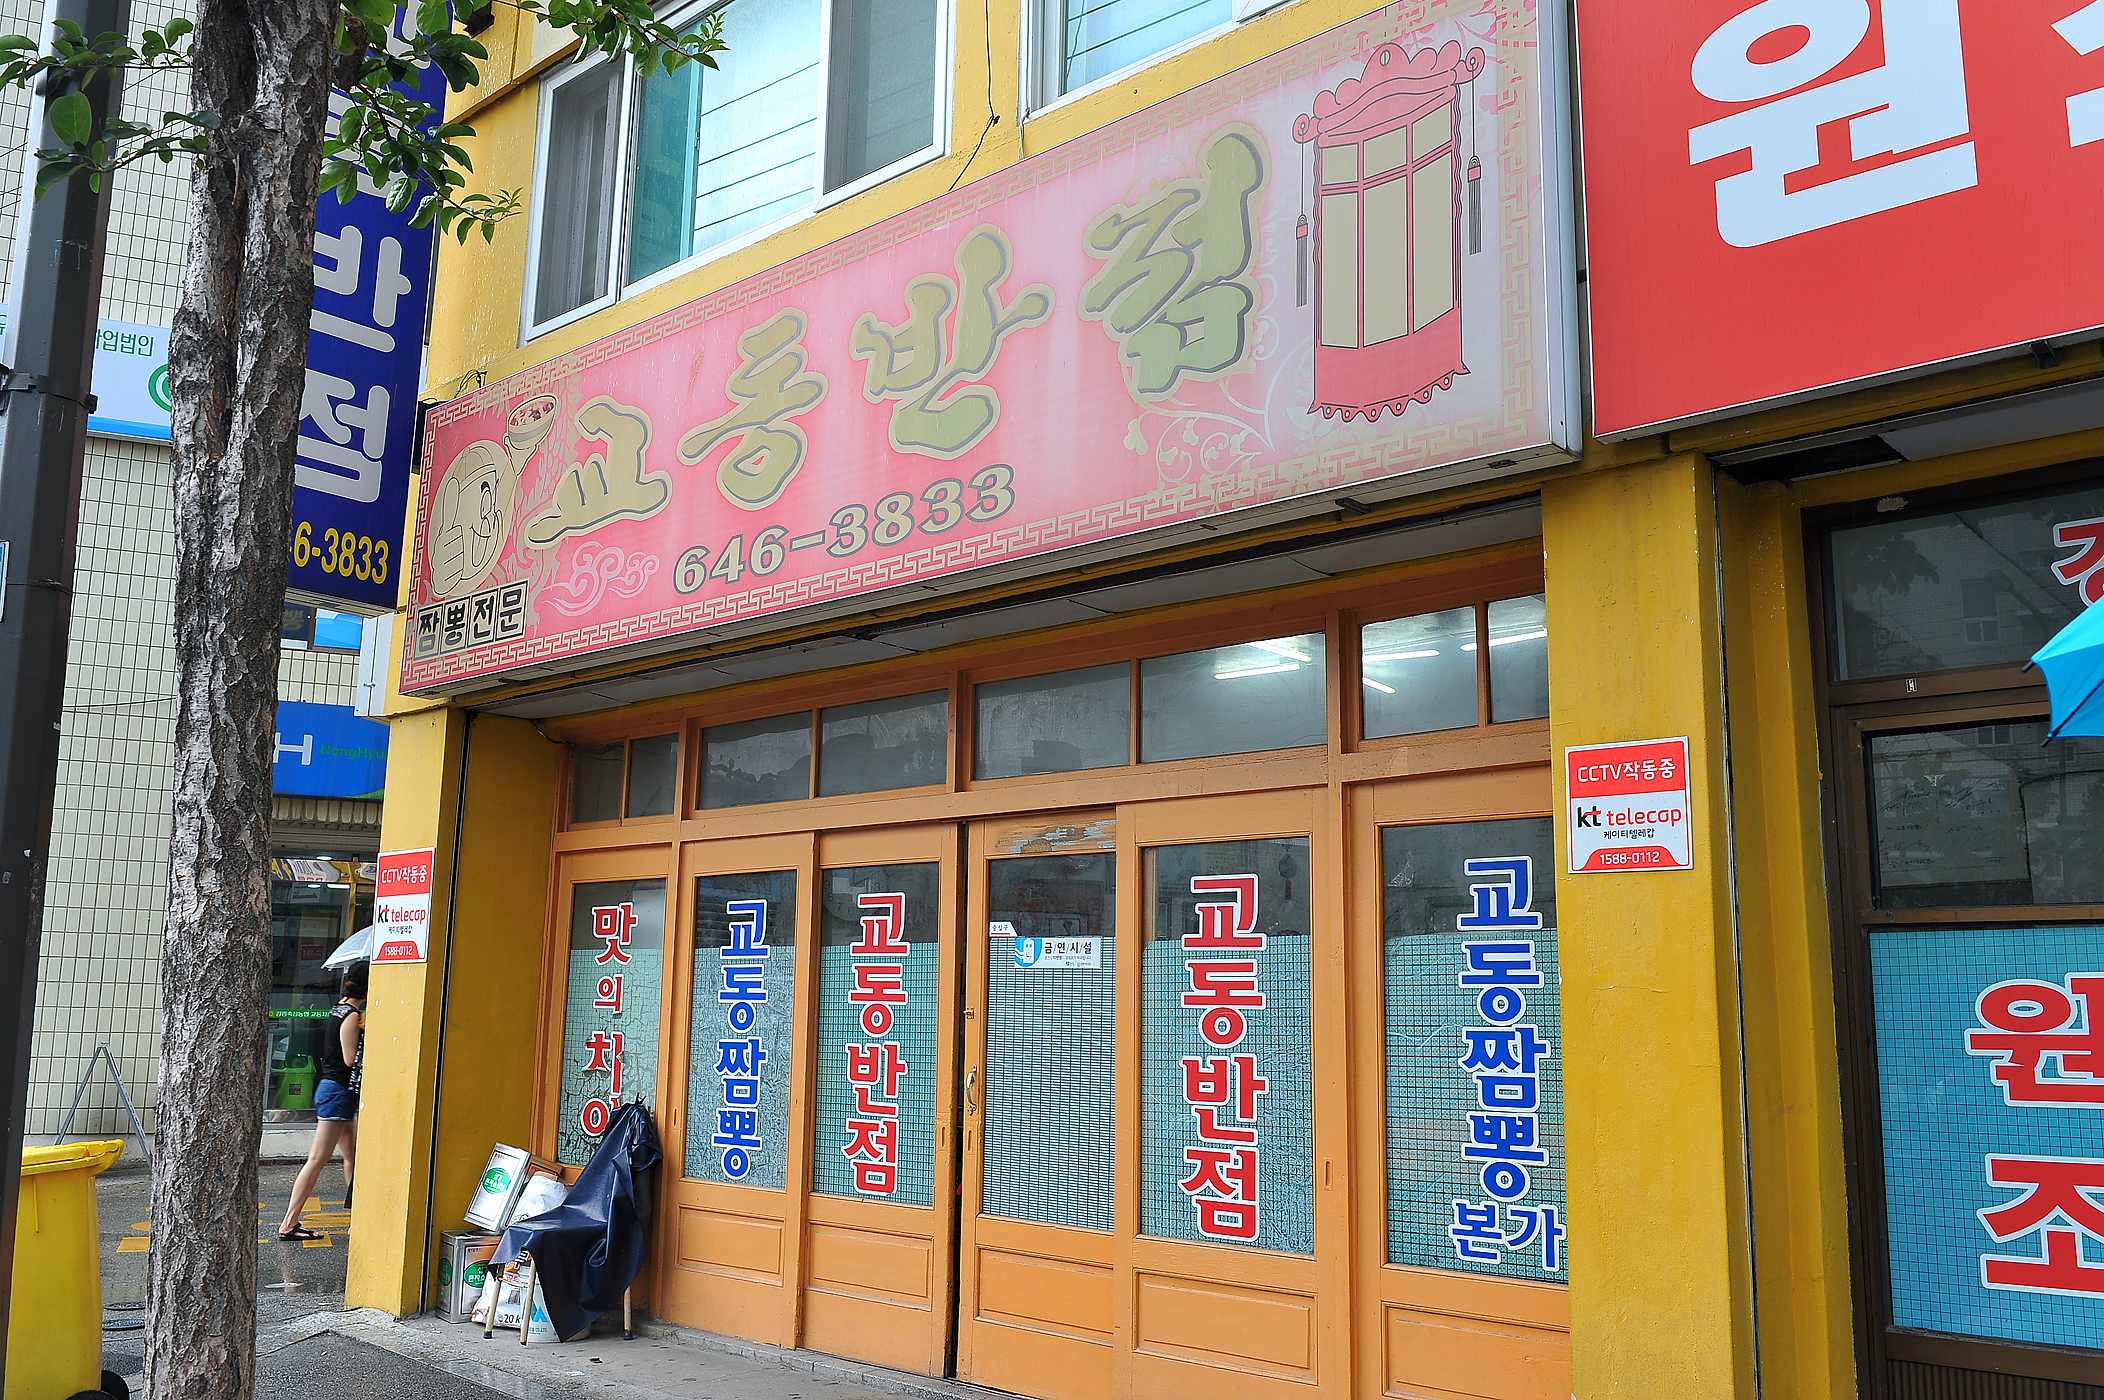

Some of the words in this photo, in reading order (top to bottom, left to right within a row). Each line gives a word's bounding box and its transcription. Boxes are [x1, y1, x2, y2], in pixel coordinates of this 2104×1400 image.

[1688, 0, 2104, 249] 원
[525, 121, 1272, 550] 교동반점
[673, 464, 1015, 595] 646-3833
[289, 521, 389, 585] 6-3833
[417, 587, 523, 653] 짬뽕전문
[1577, 758, 1676, 783] CCTV작동중
[1577, 806, 1602, 828] kt
[1606, 807, 1682, 827] telecop
[1603, 828, 1655, 840] 케이티텔레캅
[1599, 851, 1660, 866] 1588-0112
[381, 864, 428, 884] CCTV작동중
[823, 880, 831, 889] 9
[869, 869, 877, 879] 2
[873, 882, 881, 891] 3
[826, 892, 835, 902] 8
[837, 902, 844, 912] 7
[377, 904, 390, 923] kt
[391, 906, 426, 925] telecop
[847, 906, 855, 916] 6
[591, 902, 638, 1017] 맛의
[712, 899, 770, 1180] 교동짬뽕
[1457, 855, 1552, 1203] 교동짬뽕
[842, 892, 911, 1196] 교동반점
[1178, 873, 1270, 1242] 교동반점
[1964, 972, 2104, 1299] 원조
[1449, 1199, 1567, 1272] 본가
[503, 1314, 514, 1324] 20
